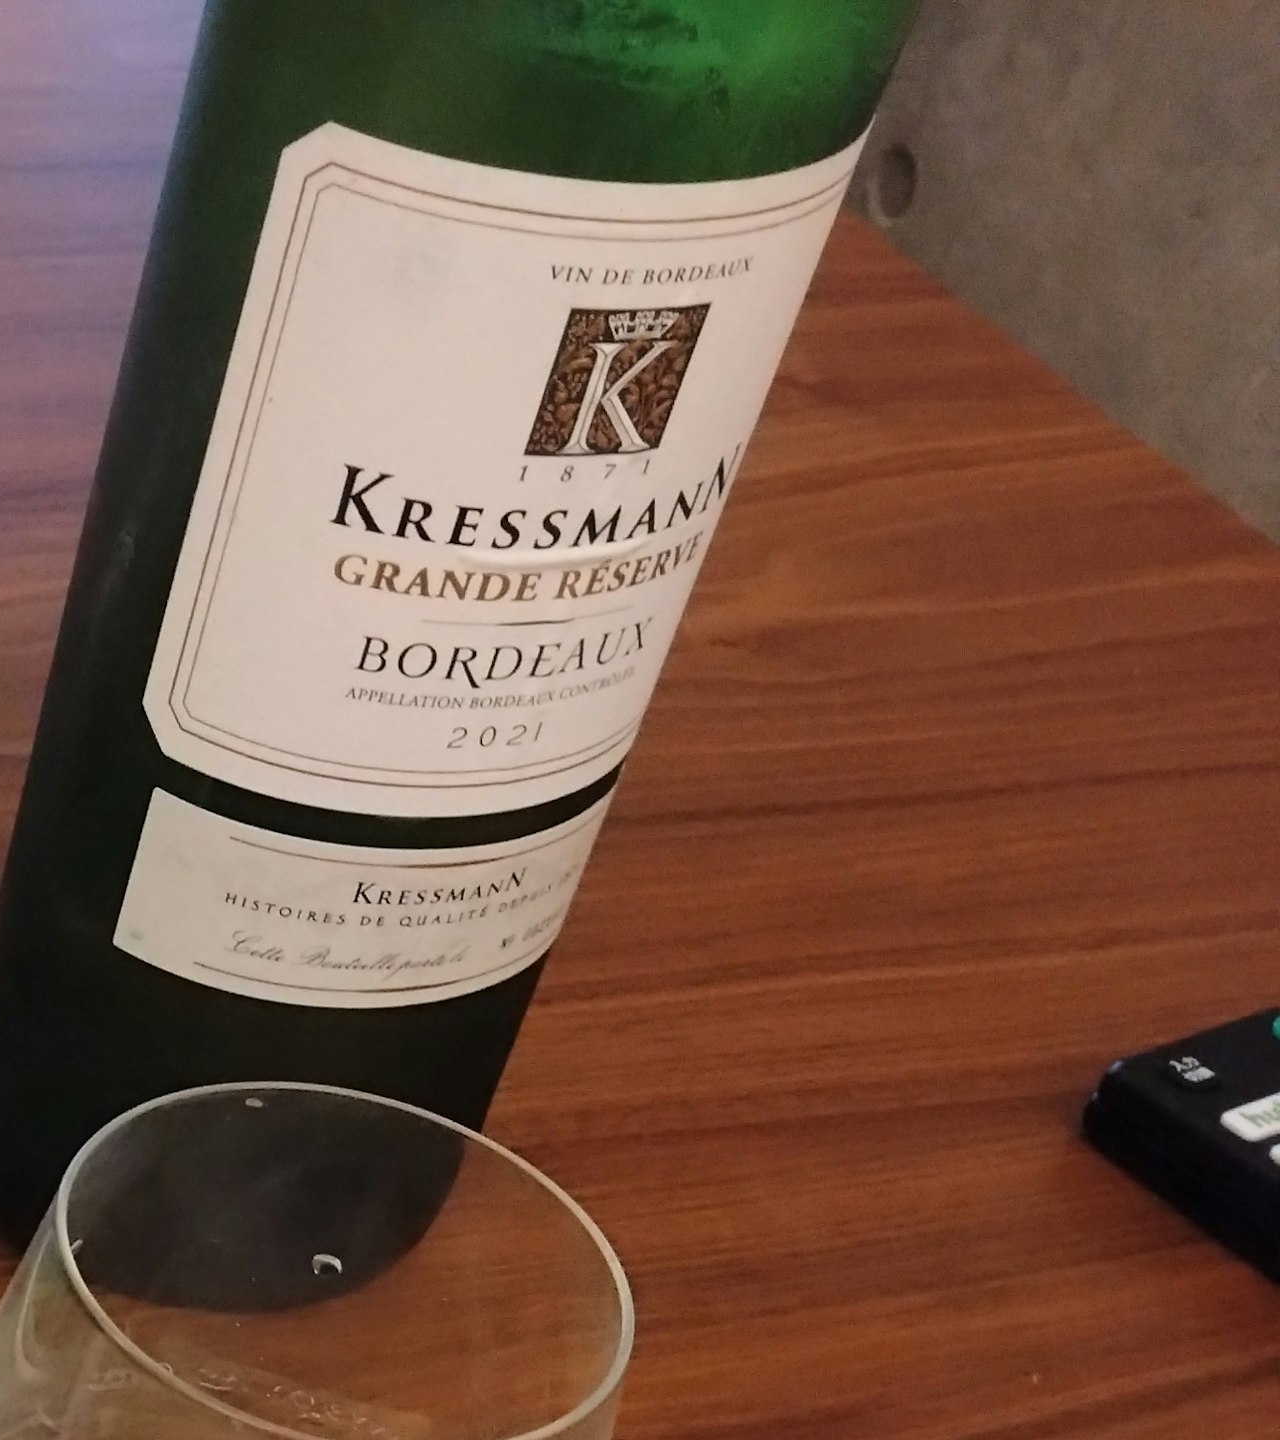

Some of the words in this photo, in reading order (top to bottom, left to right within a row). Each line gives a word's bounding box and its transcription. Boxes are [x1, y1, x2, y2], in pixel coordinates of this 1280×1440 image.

[550, 264, 594, 284] VIN
[602, 267, 634, 286] DE
[642, 255, 754, 285] BORDEAUX
[519, 458, 651, 482] 1871
[329, 441, 743, 551] KRESSMANN
[333, 553, 542, 602] GRANDE
[553, 530, 704, 600] RÉSERVE
[354, 616, 654, 689] BORDEAUX
[344, 686, 465, 710] APPELLATION
[468, 689, 558, 709] BORDEAUX
[446, 720, 544, 750] 2021
[353, 866, 529, 906] KRESSMANN
[225, 891, 346, 925] HISTOIRES
[359, 915, 385, 928] DE
[399, 904, 489, 928] QUALITÉ
